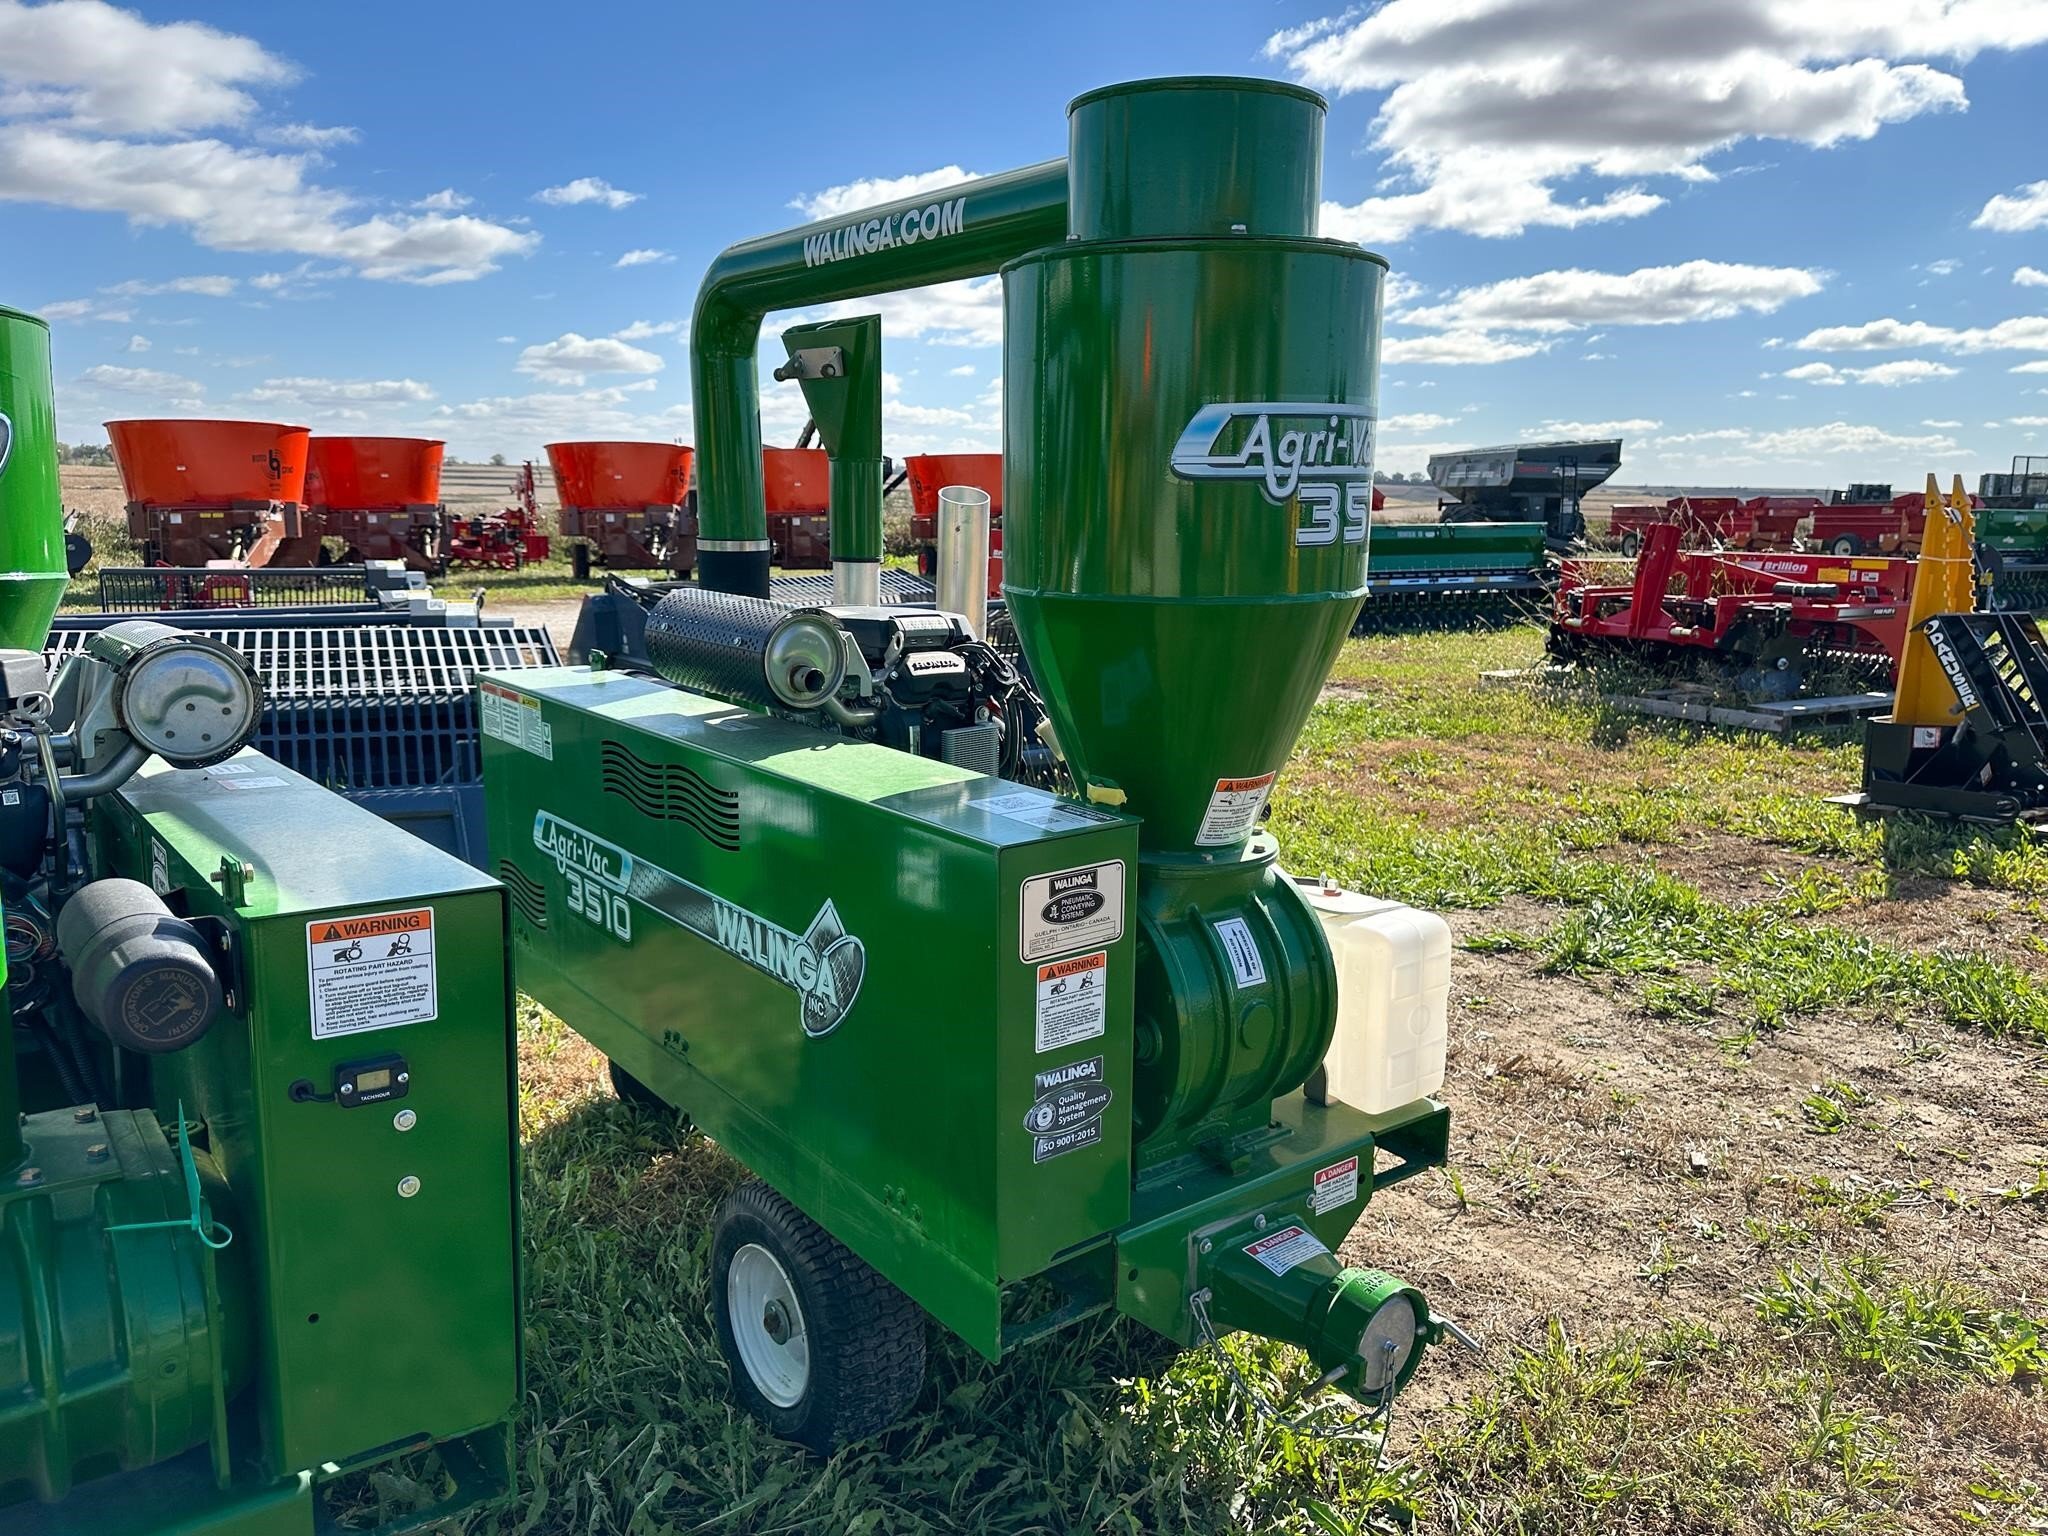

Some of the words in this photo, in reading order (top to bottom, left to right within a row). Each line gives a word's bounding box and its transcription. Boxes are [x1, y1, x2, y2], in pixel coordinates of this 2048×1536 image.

[1764, 561, 1808, 573] Brillion
[911, 661, 959, 671] HONDA
[548, 821, 611, 878] Agri-Vac
[1054, 873, 1094, 890] WALINGA
[565, 871, 632, 943] 3510
[1061, 894, 1094, 906] PNEUMATIC
[1061, 900, 1096, 914] CONVEYING
[1060, 910, 1085, 921] SYSTEMS
[343, 914, 420, 936] WARNING
[1034, 927, 1057, 938] GUELPH
[1060, 922, 1086, 932] ONTARIO
[1088, 915, 1111, 926] CANADA
[713, 898, 838, 1008] WALINGA
[1229, 938, 1243, 968] ROTATION
[334, 965, 366, 974] ROTATING
[386, 959, 412, 967] HAZARD
[1056, 957, 1099, 975] WARNING
[168, 1008, 202, 1038] INSIDE
[1043, 1062, 1096, 1088] WALINGA
[1058, 1090, 1087, 1106] Quality
[1058, 1094, 1107, 1115] Management
[1058, 1110, 1086, 1126] System
[1040, 1141, 1055, 1153] ISO
[1056, 1127, 1096, 1148] 9001:2015
[1327, 1161, 1354, 1178] DANGER
[1262, 1230, 1298, 1249] DANGER
